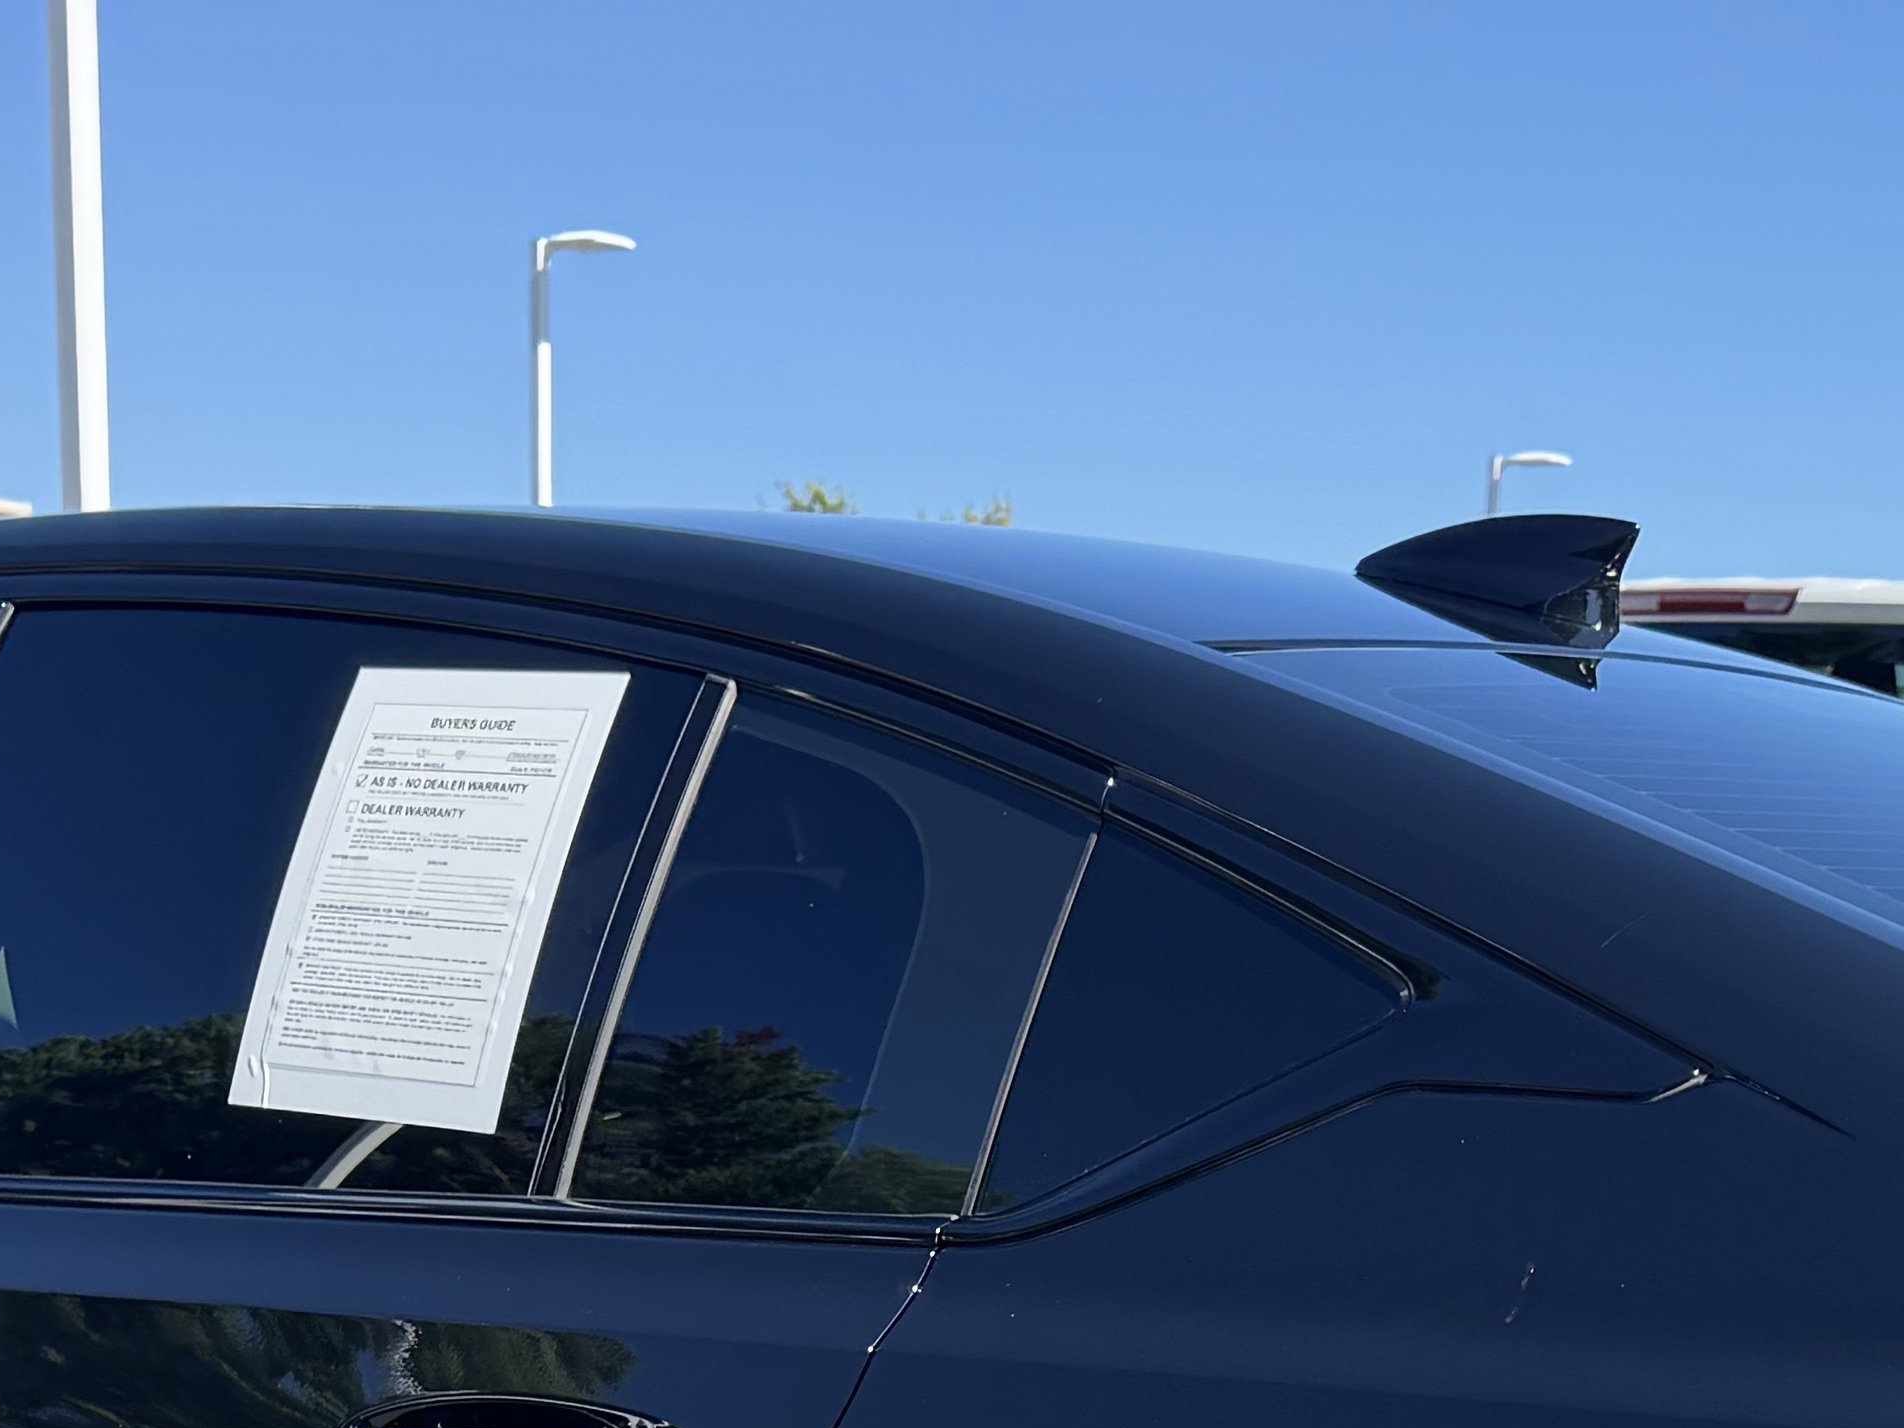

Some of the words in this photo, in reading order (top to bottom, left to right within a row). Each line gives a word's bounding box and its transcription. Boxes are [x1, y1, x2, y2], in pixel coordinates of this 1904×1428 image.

[430, 717, 476, 730] BUYERS
[479, 719, 516, 731] GUIDE
[370, 776, 385, 787] AS
[387, 777, 397, 788] IS
[405, 778, 421, 789] NO
[423, 779, 466, 791] DEALER
[468, 781, 529, 795] WARRANTY
[361, 803, 403, 816] DEALER
[405, 805, 466, 819] WARRANTY
